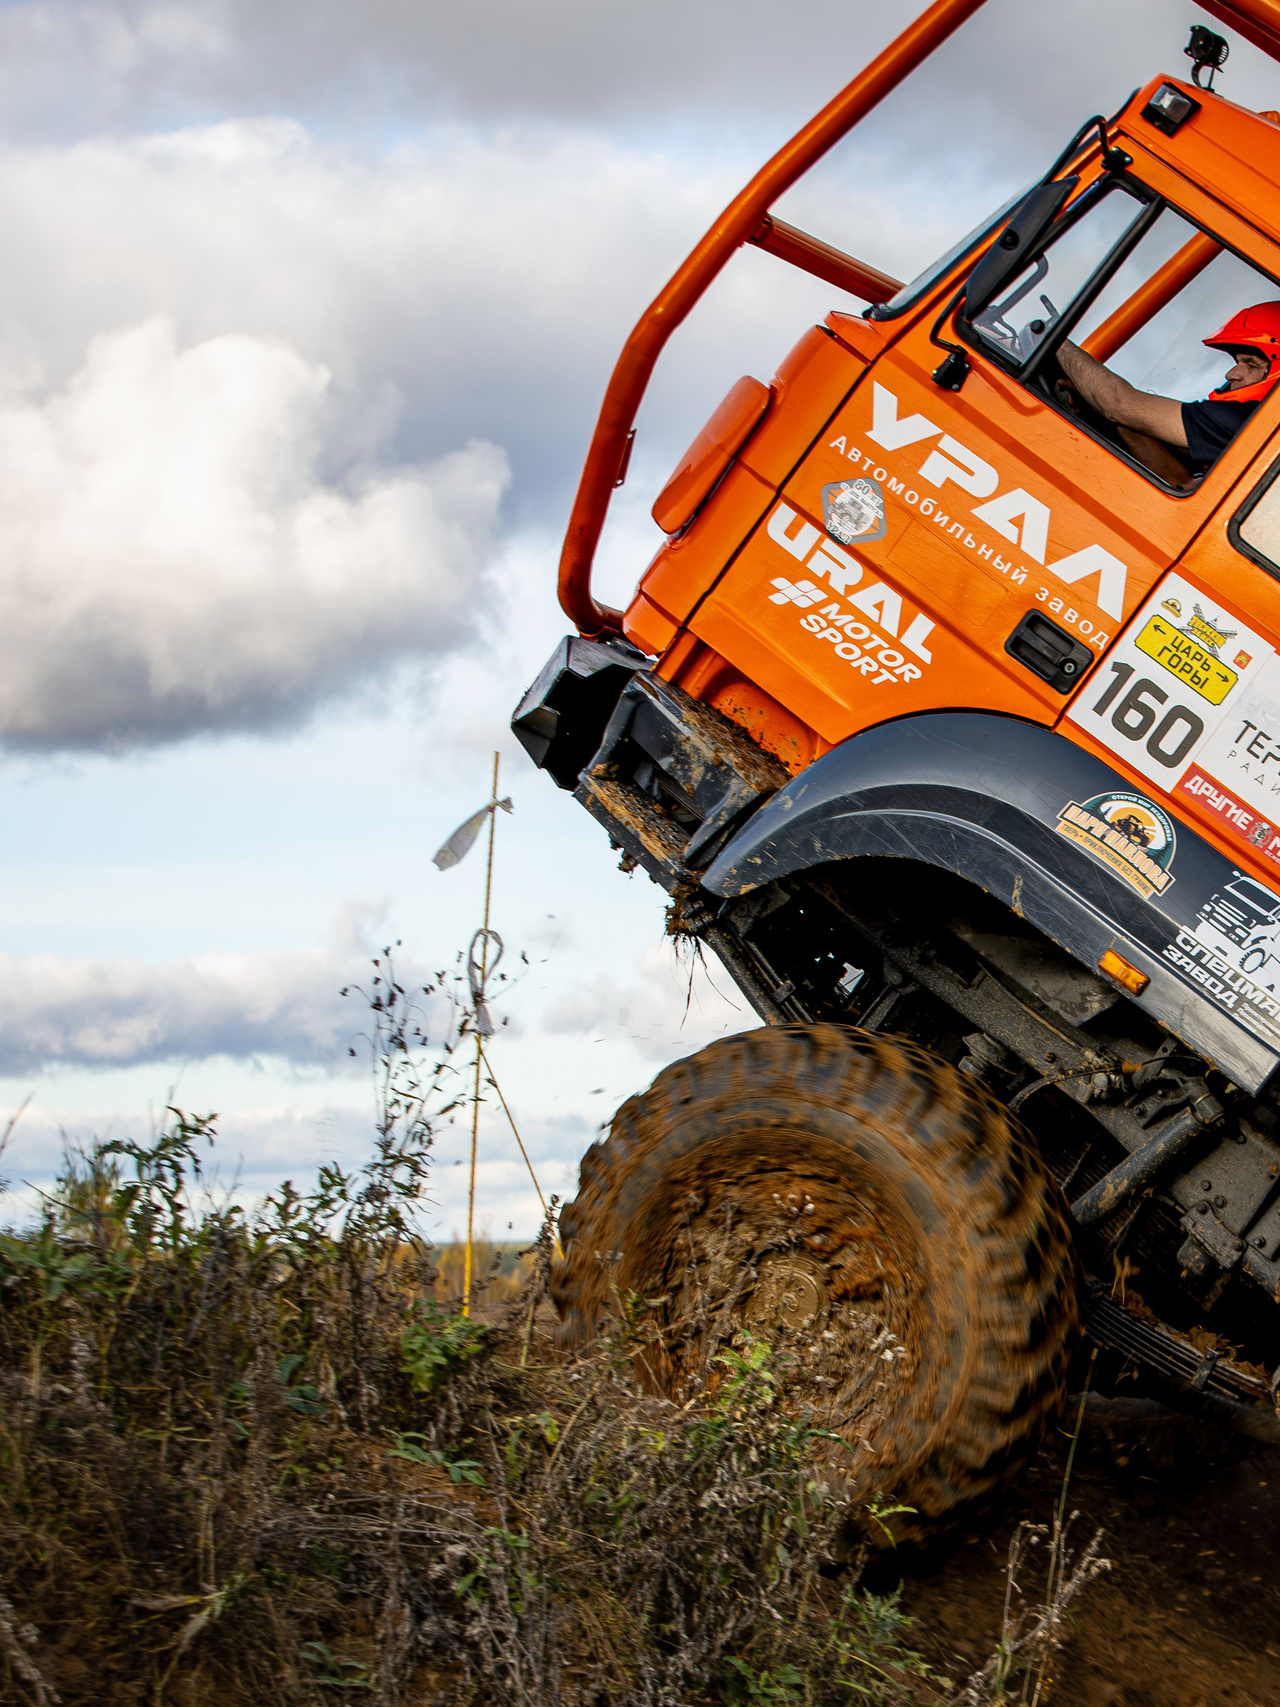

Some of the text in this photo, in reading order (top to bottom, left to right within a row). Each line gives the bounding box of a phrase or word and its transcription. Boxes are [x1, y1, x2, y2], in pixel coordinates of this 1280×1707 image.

[829, 435, 1027, 585] Автомобильный
[854, 480, 870, 495] 80
[865, 380, 1128, 623] УРАЛ
[767, 503, 936, 665] URAL
[800, 614, 898, 686] SPORT
[819, 602, 922, 684] MOTOR
[1157, 645, 1209, 690] ГОРЫ
[1169, 635, 1211, 672] ЦАРЬ
[1092, 660, 1204, 769] 160
[1183, 775, 1253, 831] ДРУГИЕ
[1062, 804, 1170, 891] ПАРК ПАВЛОВА
[1162, 945, 1239, 1009] ЗАВОД
